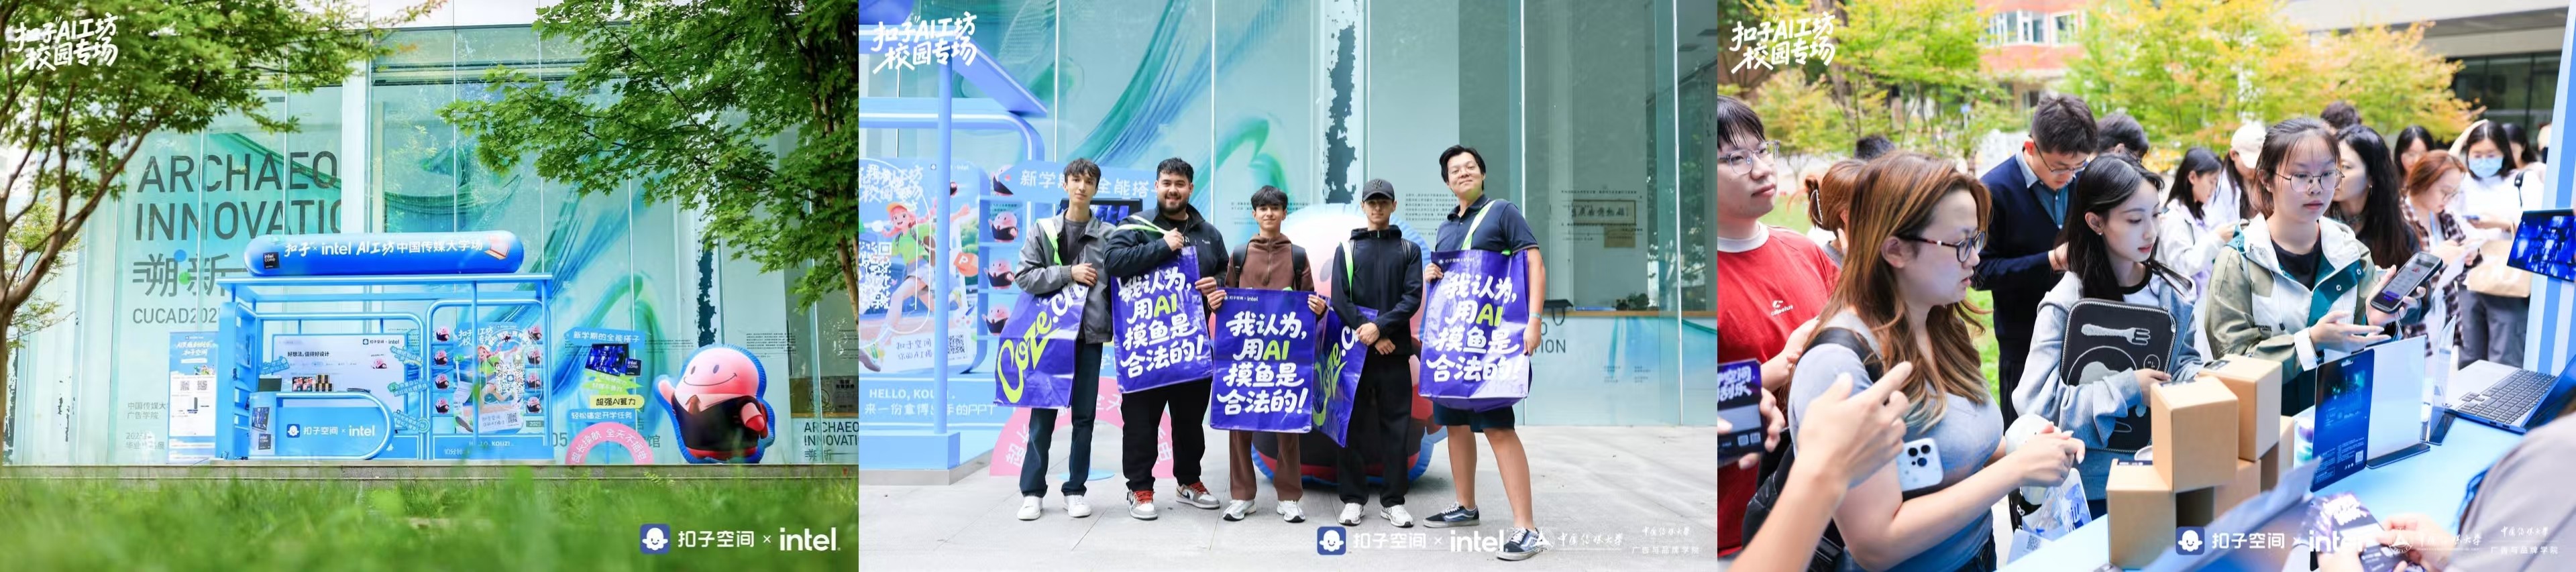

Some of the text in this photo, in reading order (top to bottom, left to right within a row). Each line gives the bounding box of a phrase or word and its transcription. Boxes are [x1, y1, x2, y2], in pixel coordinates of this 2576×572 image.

[137, 150, 337, 192] ARCHAEO
[321, 241, 352, 256] intel
[133, 308, 220, 323] CUCAD202
[1126, 293, 1177, 324] 用AI
[1445, 300, 1504, 327] 用AI
[1122, 313, 1198, 351] 摸鱼是
[1433, 326, 1520, 355] 摸鱼是
[1232, 338, 1290, 361] 用AI
[1223, 362, 1305, 388] 摸鱼是
[127, 402, 168, 410] 中国传媒大
[303, 425, 375, 437] 扣子空间 intel
